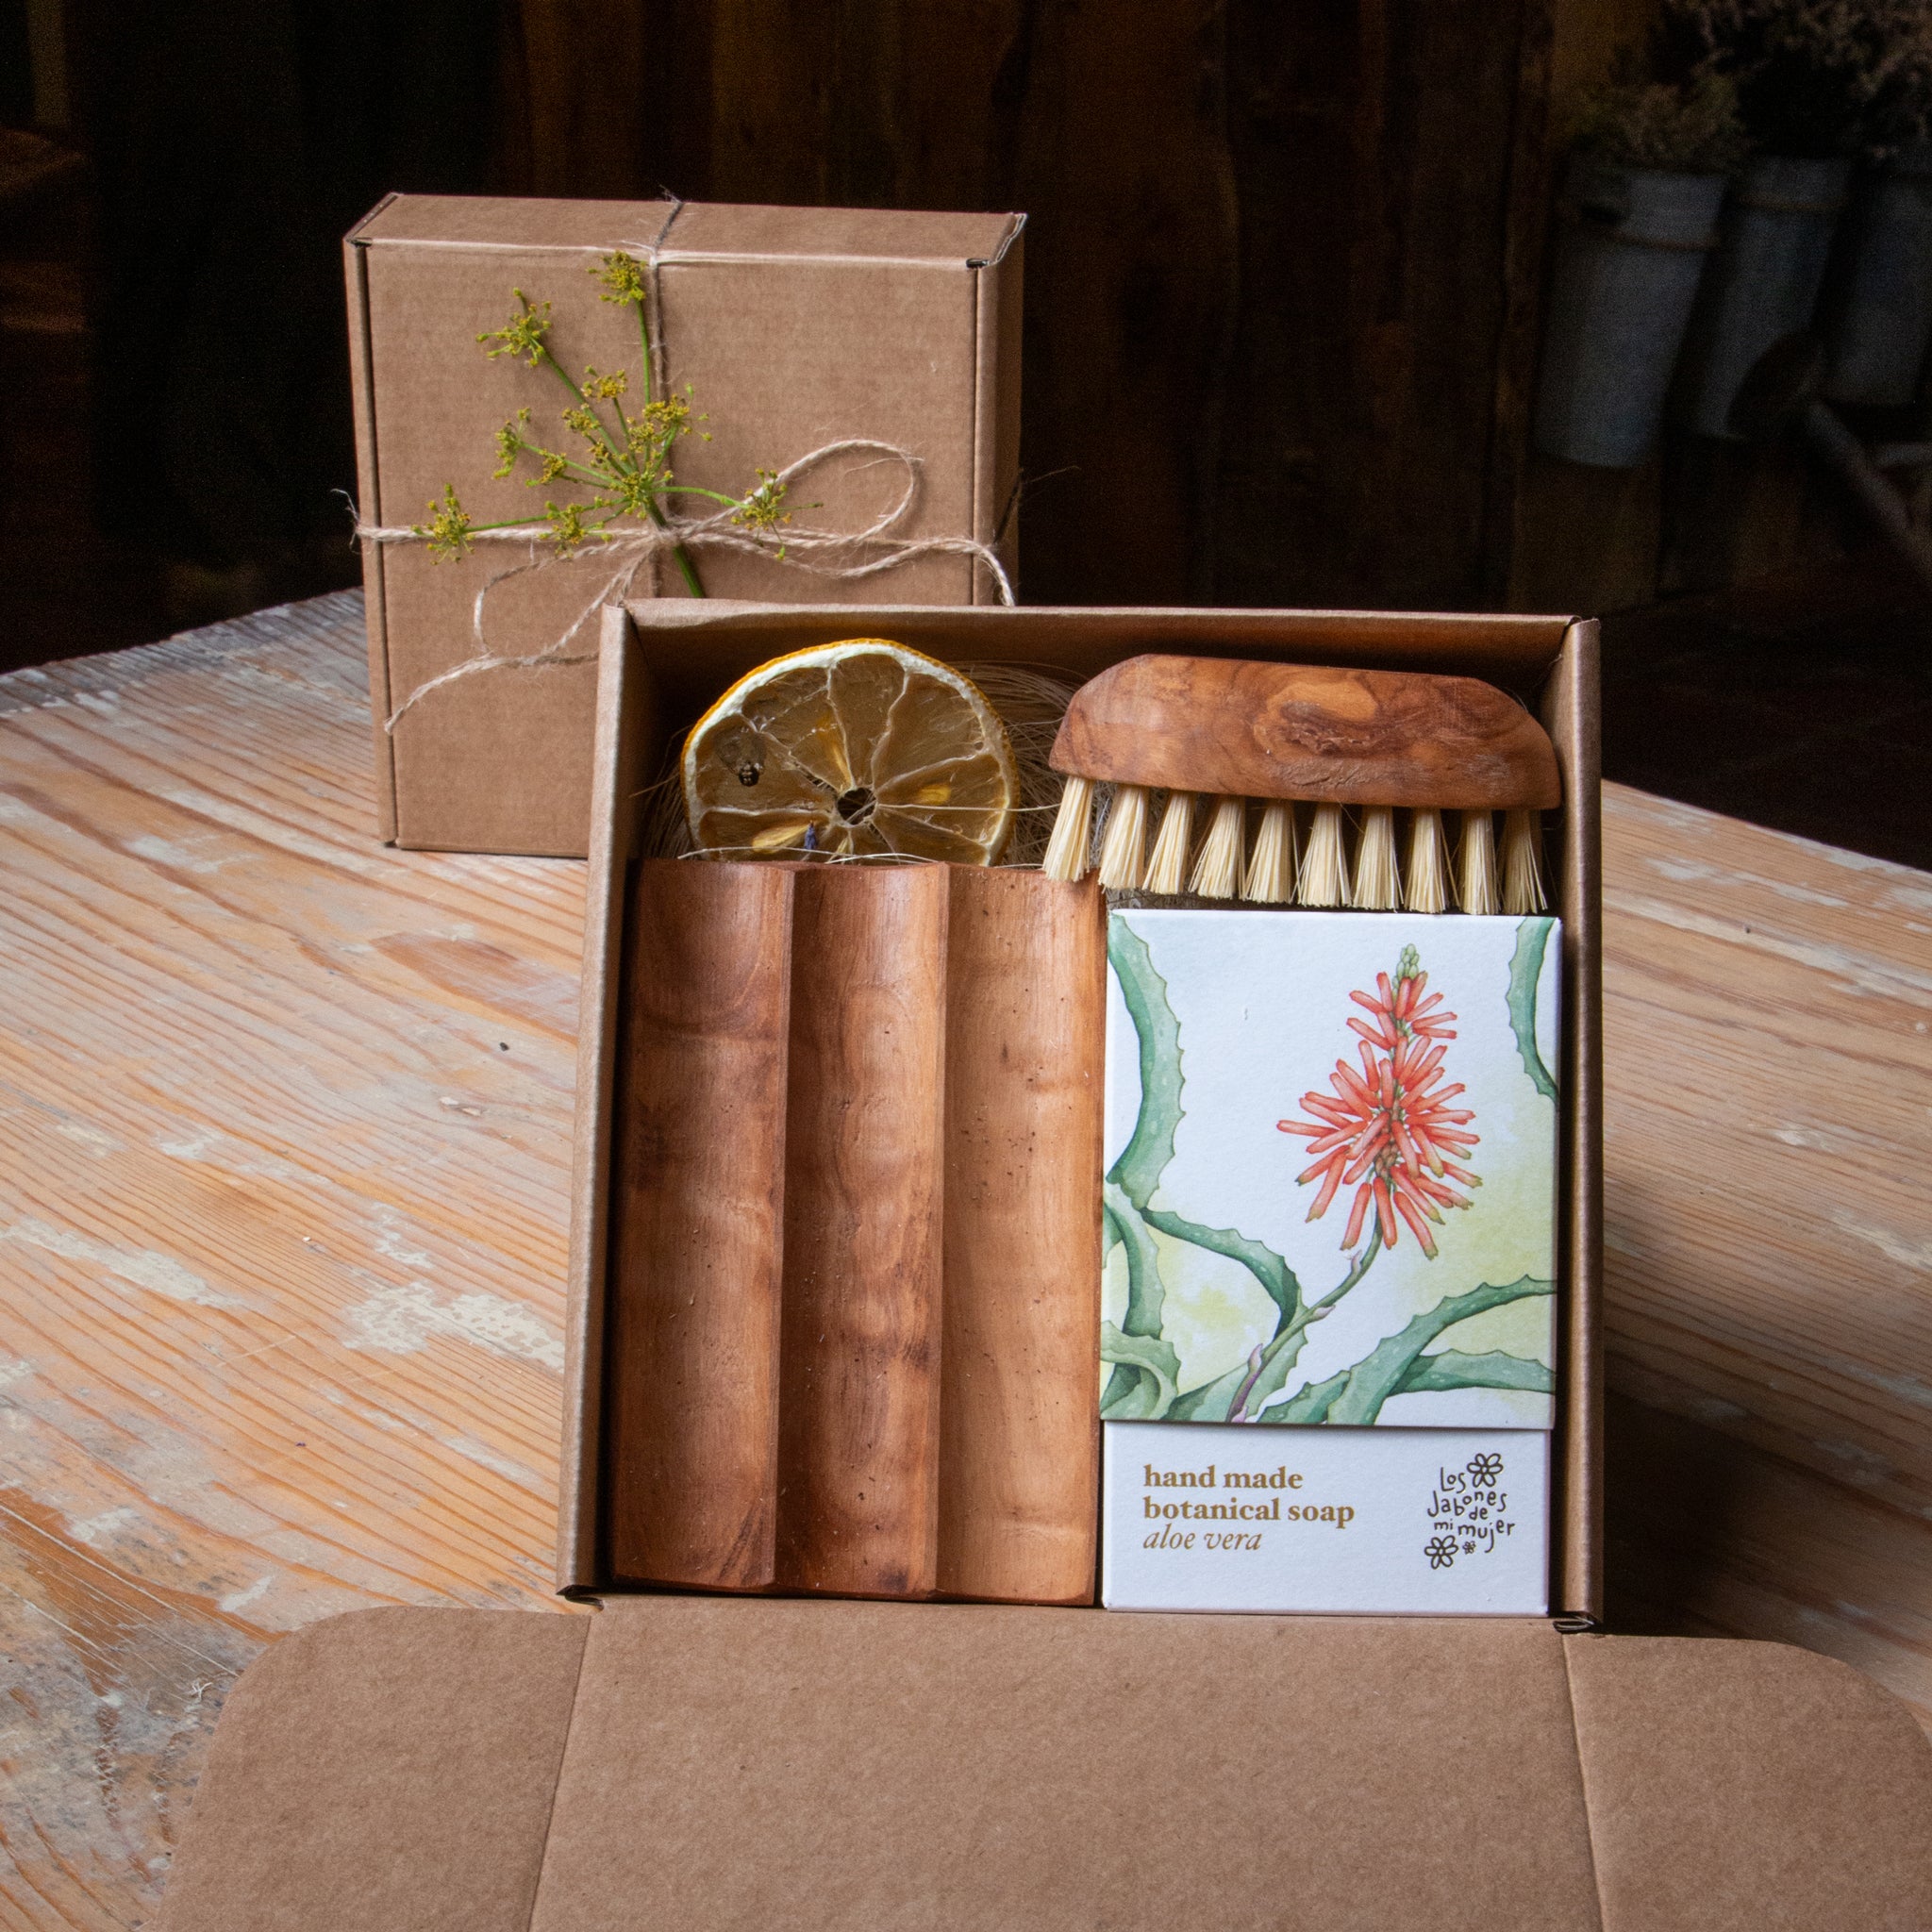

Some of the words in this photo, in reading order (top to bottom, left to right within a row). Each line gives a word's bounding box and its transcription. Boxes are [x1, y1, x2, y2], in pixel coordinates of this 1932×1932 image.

[1142, 1463, 1217, 1488] hand
[1223, 1465, 1304, 1490] made
[1440, 1466, 1466, 1494] Los
[1142, 1495, 1281, 1521] botanical
[1287, 1504, 1355, 1529] soap
[1426, 1490, 1508, 1518] Jabones
[1468, 1506, 1489, 1521] de
[1142, 1523, 1196, 1550] aloe
[1203, 1532, 1263, 1551] vera
[1434, 1518, 1454, 1530] mi
[1457, 1519, 1516, 1554] mujer
